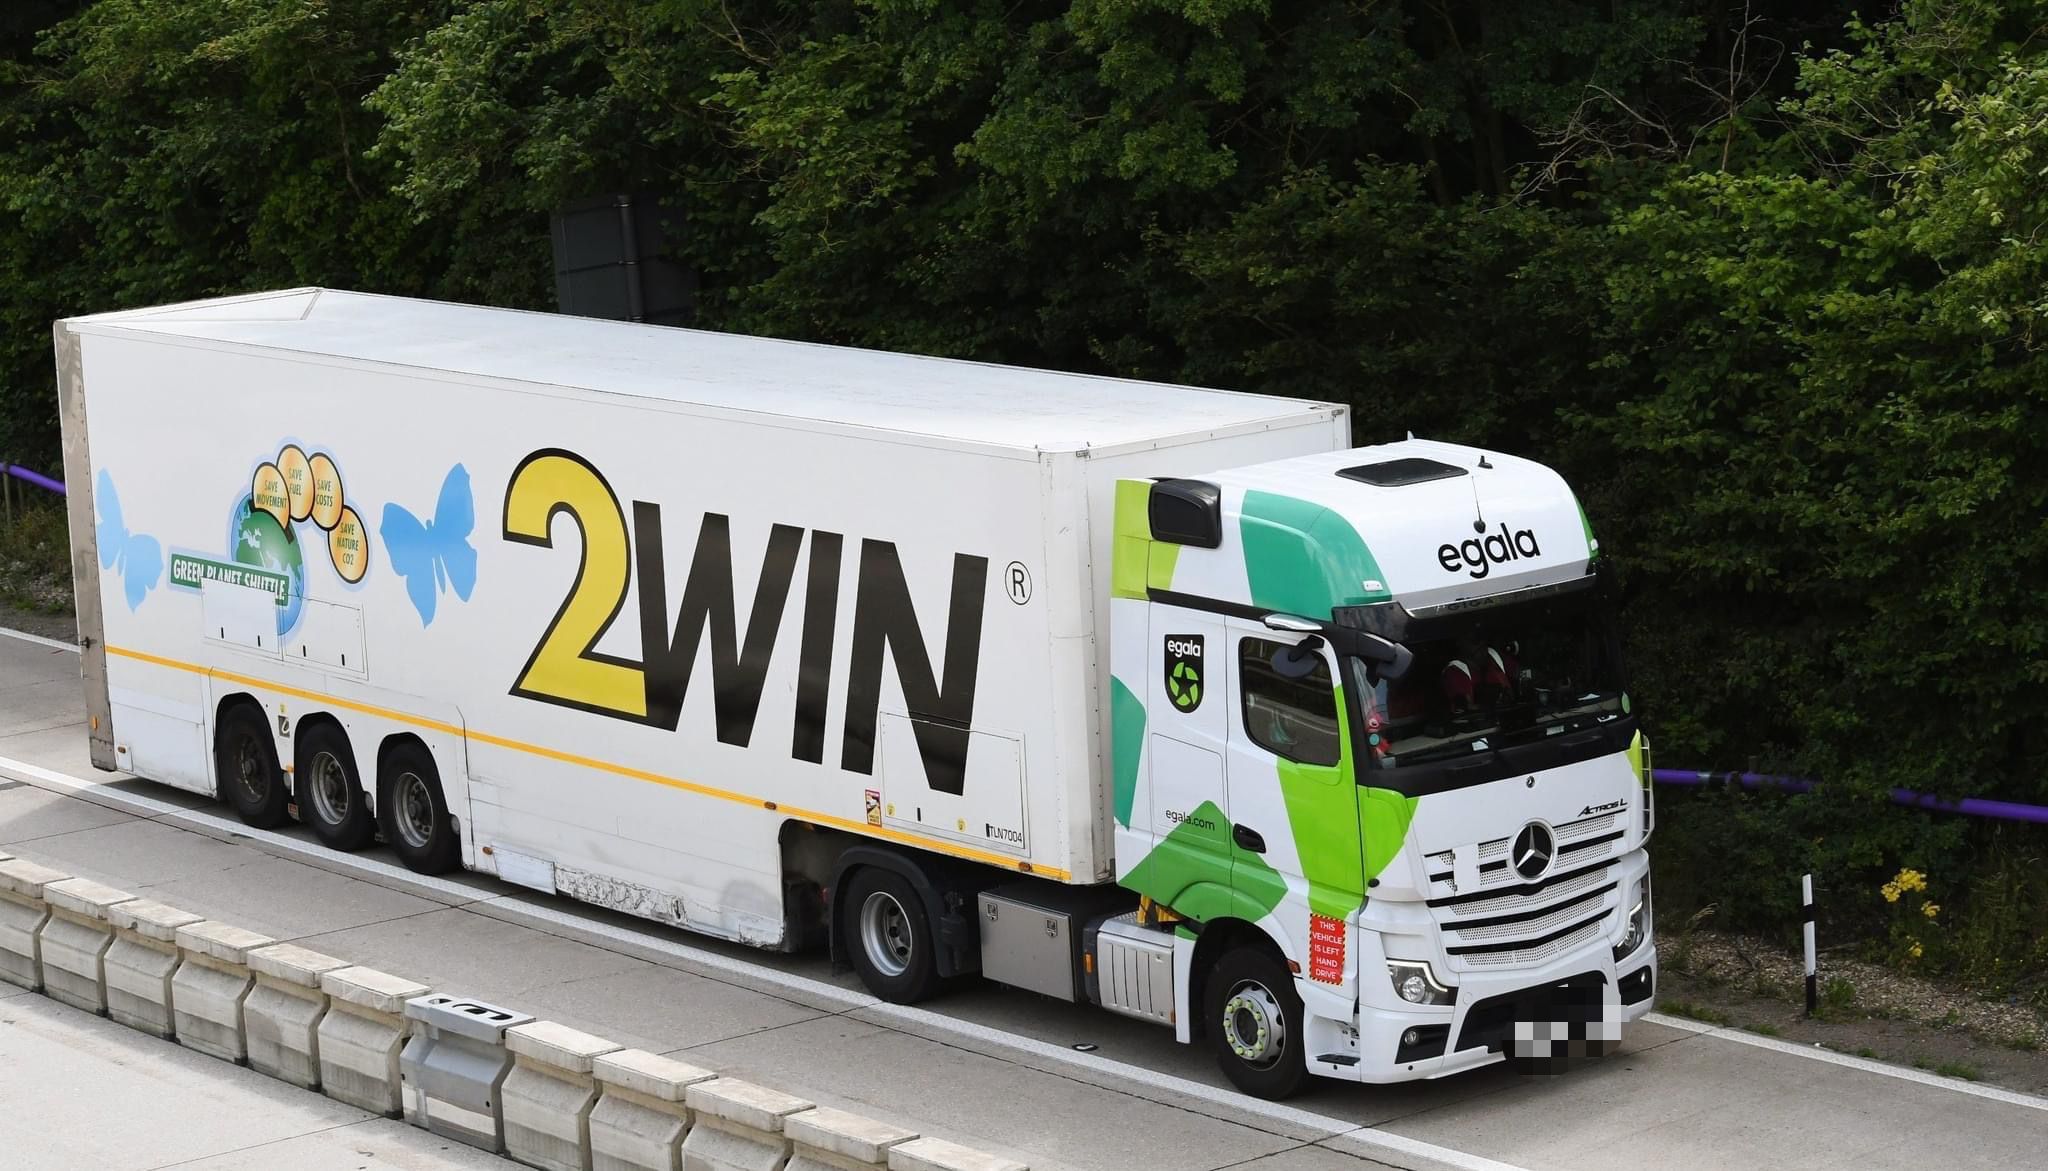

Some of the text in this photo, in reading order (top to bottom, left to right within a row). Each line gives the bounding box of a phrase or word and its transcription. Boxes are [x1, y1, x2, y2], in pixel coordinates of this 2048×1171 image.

[288, 468, 302, 480] SAVE
[264, 480, 278, 492] SAVE
[289, 483, 302, 496] FUEL
[317, 480, 331, 492] SAVE
[256, 494, 287, 508] MOVEMENT
[316, 494, 333, 507] COSTS
[340, 523, 355, 535] SAVE
[337, 537, 359, 551] NATURE
[1437, 522, 1541, 579] egala
[342, 553, 354, 565] CO2
[173, 558, 205, 582] GREEN
[502, 447, 989, 796] 2WIN
[1167, 639, 1201, 658] egala
[1165, 808, 1216, 832] egala.com
[1319, 921, 1336, 931] THIS
[1312, 931, 1343, 944] VEHICLE
[1314, 944, 1340, 956] IS LEFT
[1316, 957, 1338, 968] HAND
[1315, 968, 1337, 979] DRIVE
